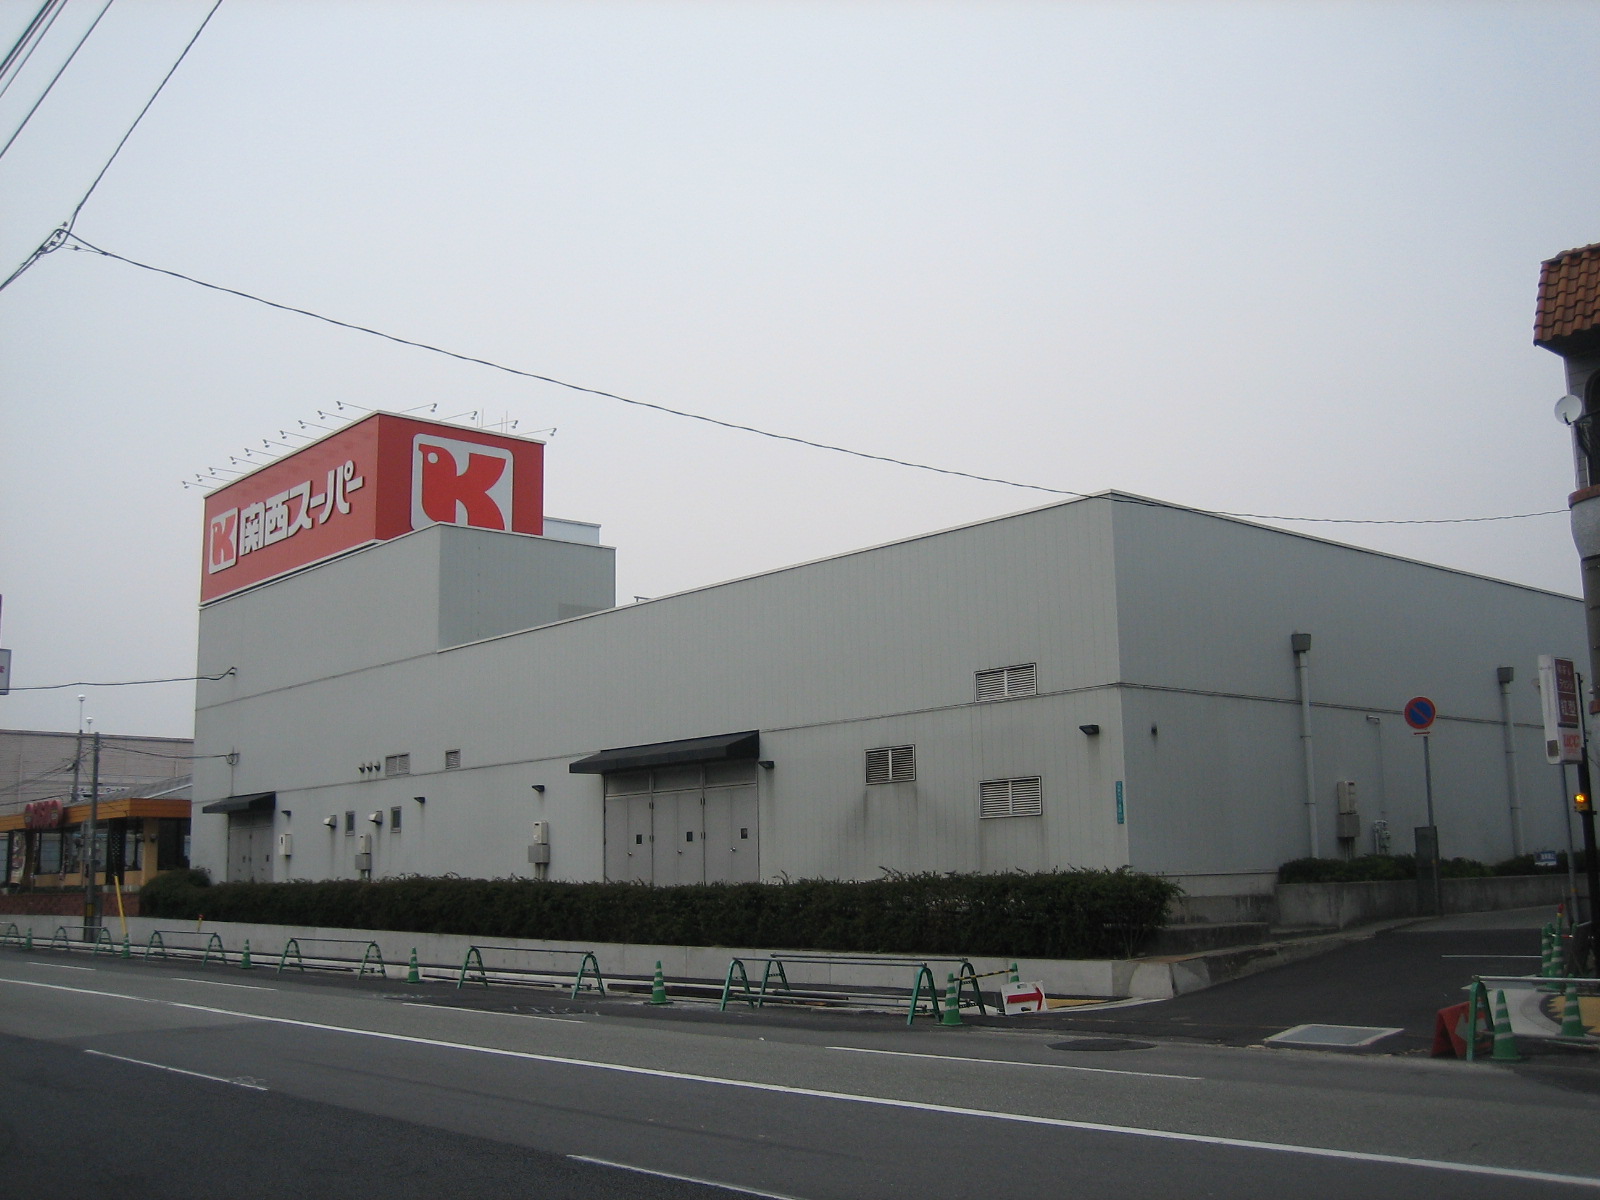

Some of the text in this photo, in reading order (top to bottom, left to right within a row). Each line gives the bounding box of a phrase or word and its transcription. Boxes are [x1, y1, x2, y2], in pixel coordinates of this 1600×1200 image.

[239, 460, 365, 557] 関西スーパー
[1562, 734, 1580, 748] UCC
